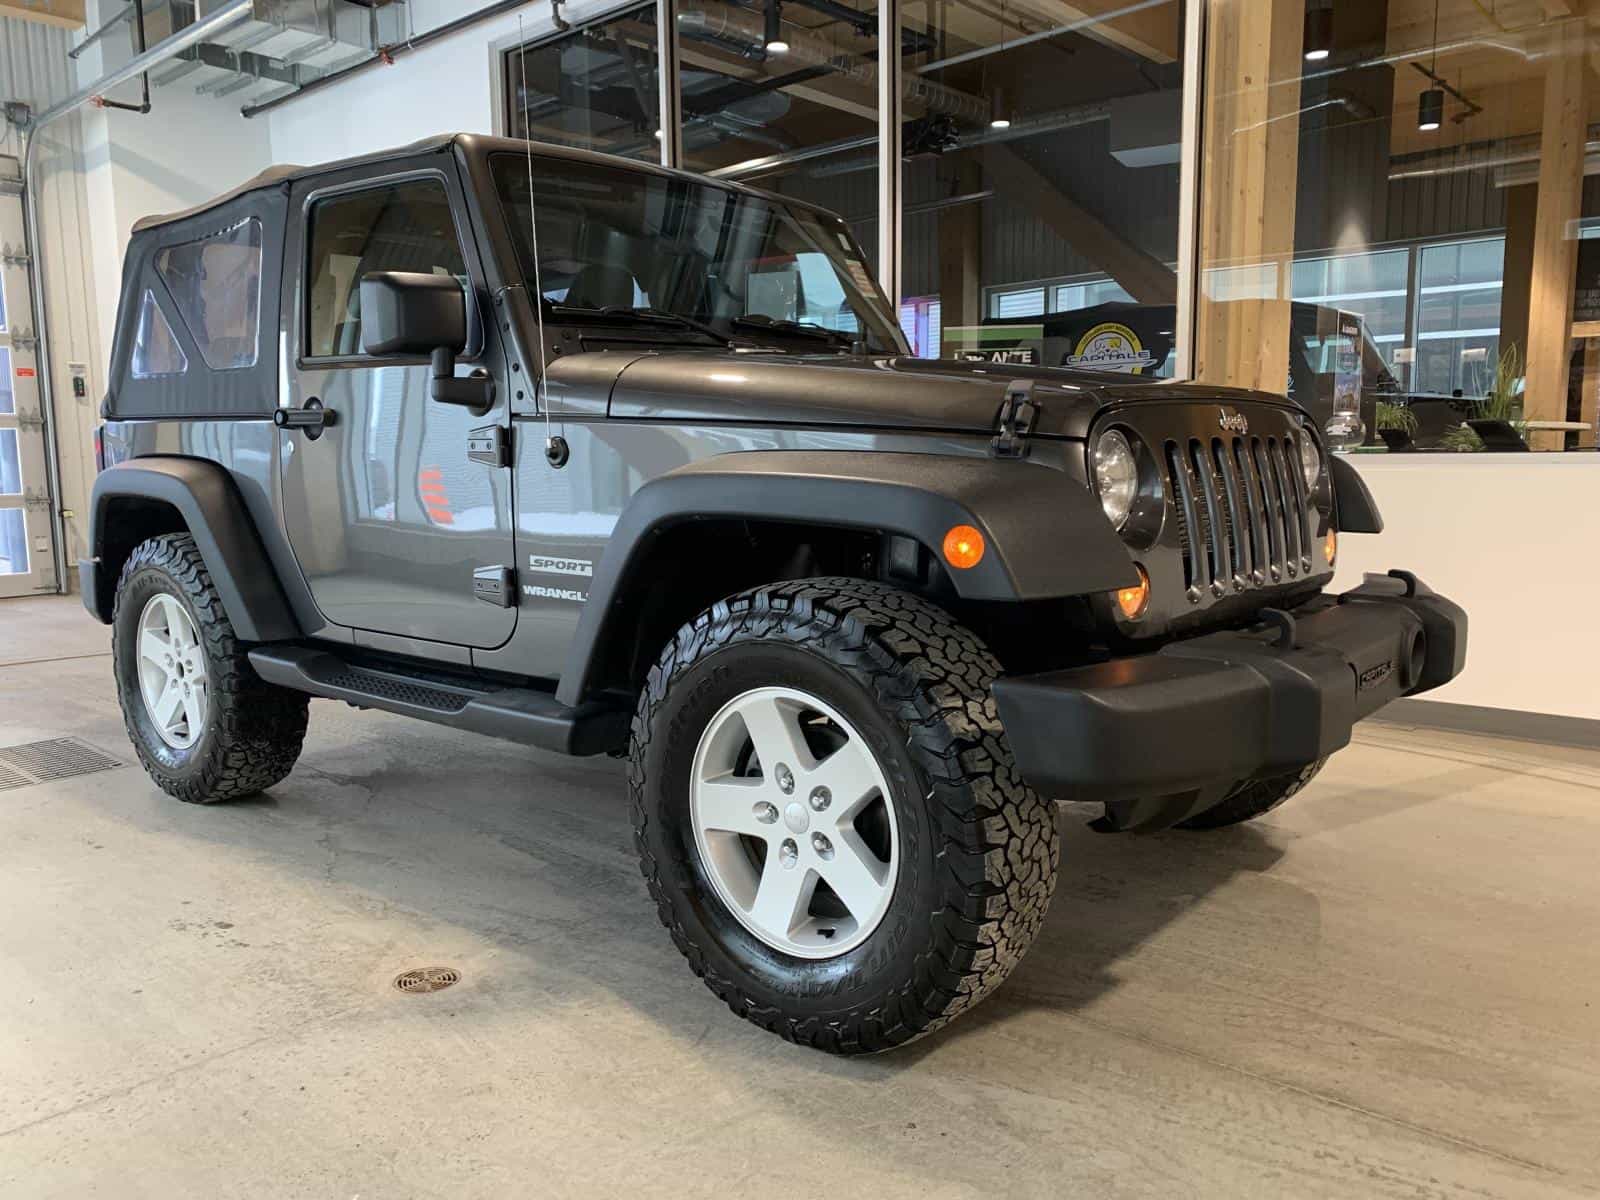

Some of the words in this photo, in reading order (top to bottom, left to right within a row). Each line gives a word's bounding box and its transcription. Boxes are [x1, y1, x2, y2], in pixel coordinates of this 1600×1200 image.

[1067, 351, 1149, 365] CAPITALE
[1219, 408, 1248, 434] Jeep
[529, 558, 593, 572] SPORT
[522, 585, 589, 602] WRANGL
